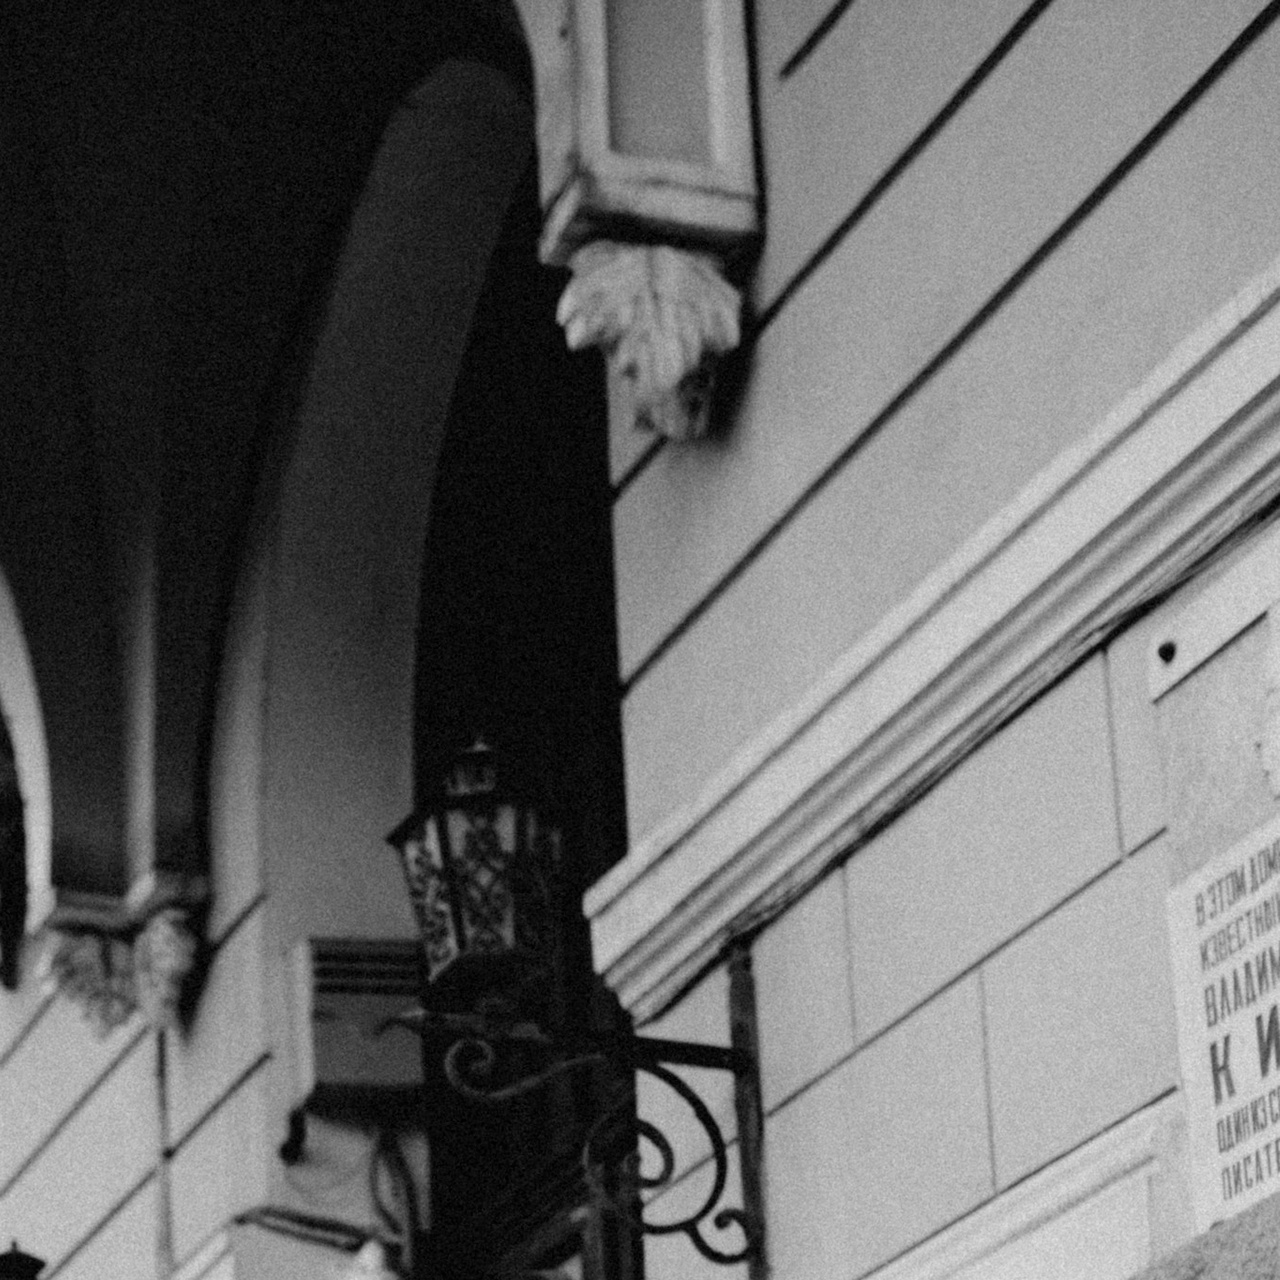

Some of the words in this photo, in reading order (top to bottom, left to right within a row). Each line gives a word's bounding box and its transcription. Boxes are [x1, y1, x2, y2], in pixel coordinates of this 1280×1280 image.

[1207, 864, 1247, 920] ЭТОМ
[1217, 1105, 1251, 1153] ОДИН
[1269, 1085, 1280, 1125] С
